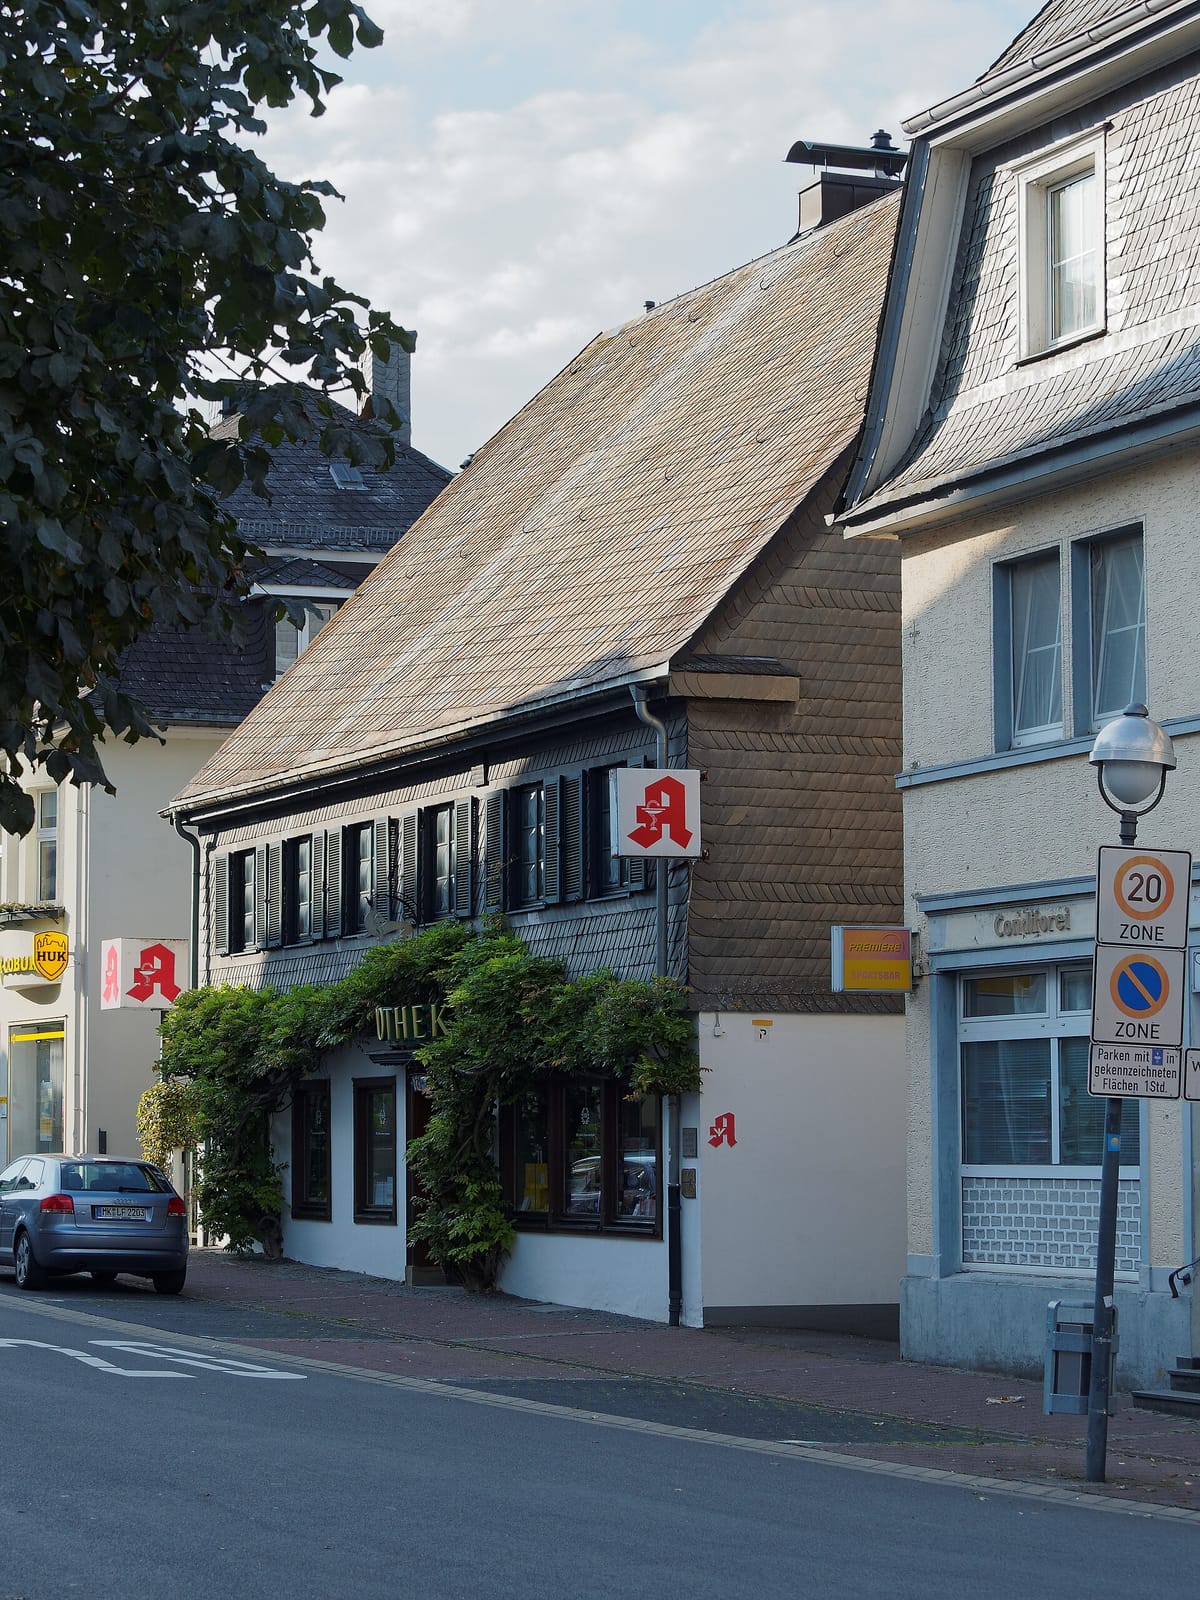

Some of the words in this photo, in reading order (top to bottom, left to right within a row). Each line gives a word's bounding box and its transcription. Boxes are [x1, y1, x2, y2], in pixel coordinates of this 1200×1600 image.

[1128, 872, 1162, 903] 20
[1119, 923, 1165, 942] ZONE
[37, 951, 67, 962] HUK
[849, 943, 902, 953] PREMIERE
[375, 1004, 450, 1041] OTHEK
[1115, 1021, 1161, 1040] ZONE
[1097, 1047, 1130, 1062] Parken
[1134, 1051, 1150, 1063] mit
[1166, 1052, 1175, 1064] in
[1094, 1064, 1177, 1079] gekennzeichneten
[1102, 1078, 1139, 1092] Flächen
